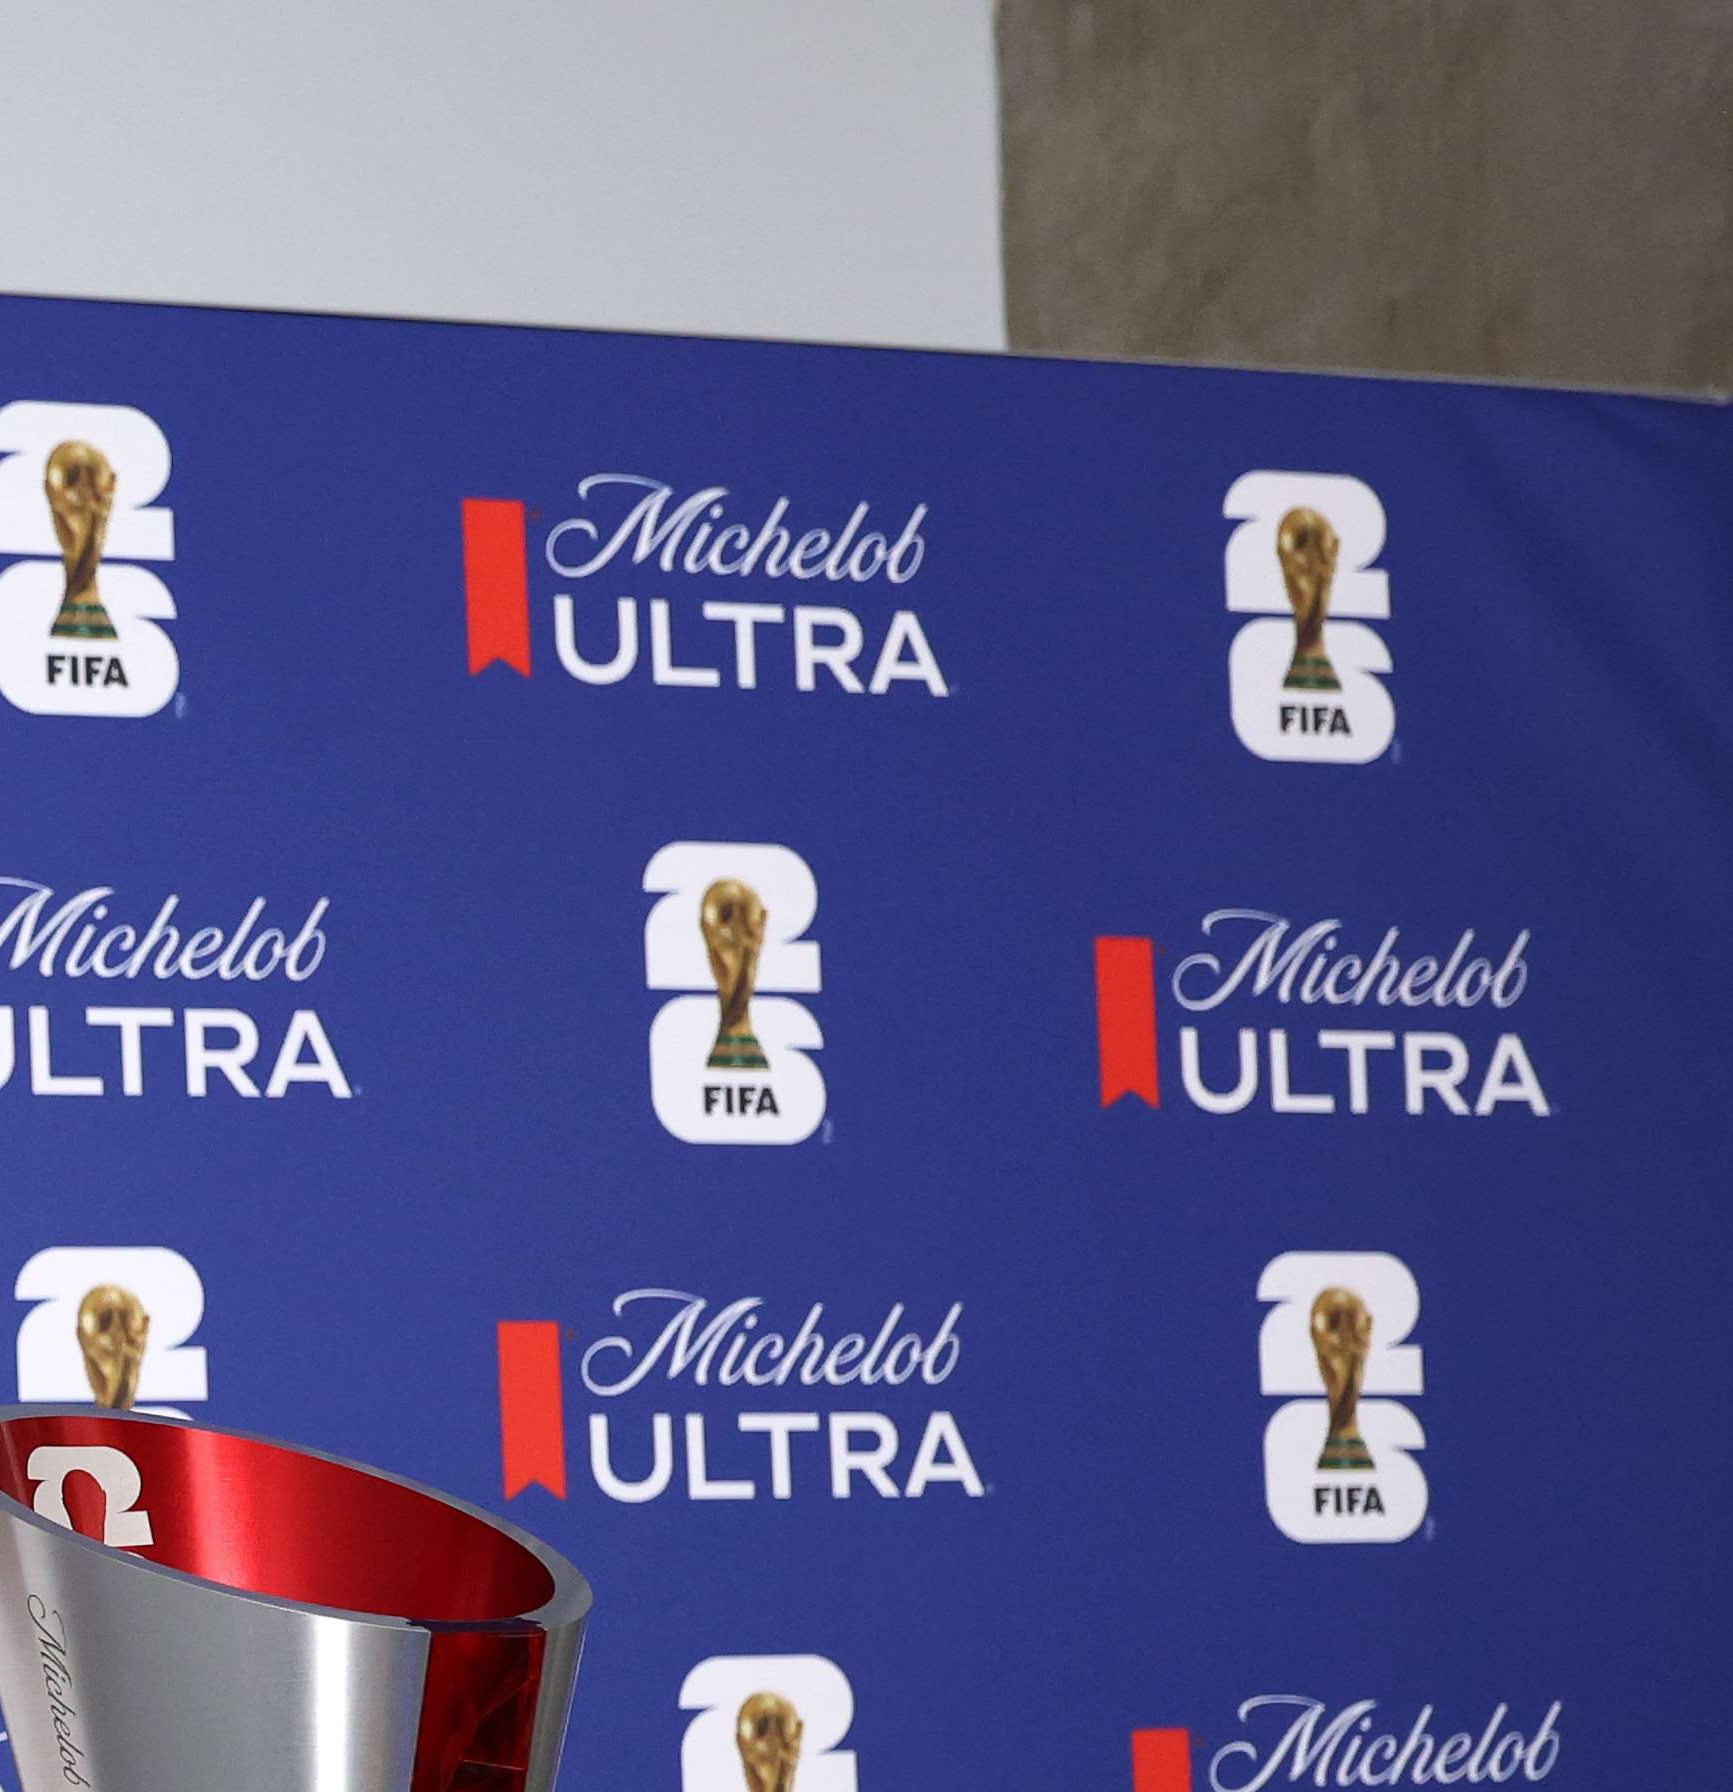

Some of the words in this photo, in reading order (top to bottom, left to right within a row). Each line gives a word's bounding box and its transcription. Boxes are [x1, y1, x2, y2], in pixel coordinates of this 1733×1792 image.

[547, 475, 926, 583] Michelob
[47, 655, 128, 686] FIFA
[555, 595, 947, 696] ULTRA
[1281, 706, 1350, 733] FIFA
[1173, 910, 1529, 1010] Michelob
[705, 1087, 778, 1114] FIFA
[1181, 1028, 1549, 1116] ULTRA
[582, 1289, 961, 1395] Michelob
[590, 1412, 983, 1502] ULTRA
[1315, 1487, 1384, 1513] FIFA
[27, 1594, 91, 1788] Michelob
